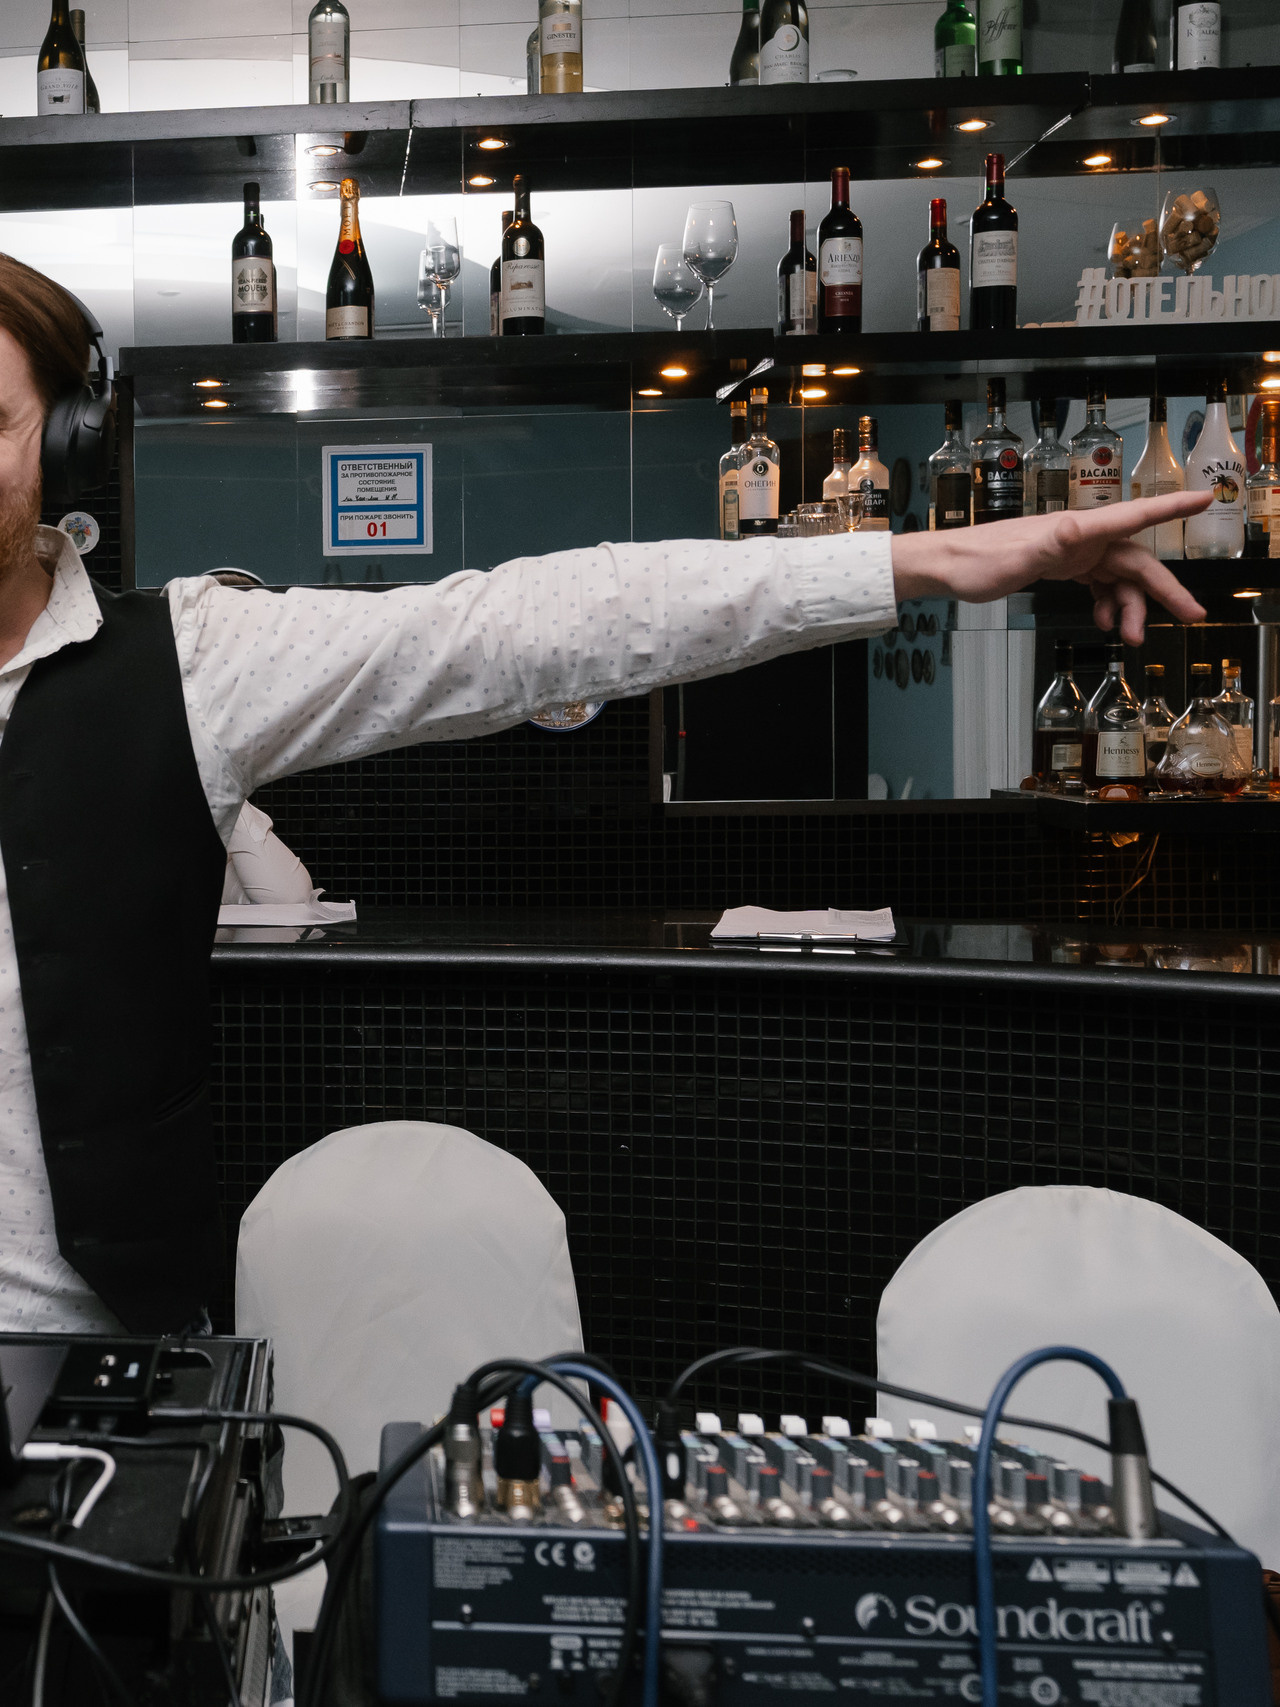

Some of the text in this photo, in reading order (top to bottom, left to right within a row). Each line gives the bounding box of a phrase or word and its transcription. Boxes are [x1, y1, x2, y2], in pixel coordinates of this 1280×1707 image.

[828, 253, 861, 264] ARIENZO
[341, 461, 413, 471] ОТВЕТСТВЕННЫЙ
[744, 480, 776, 488] ОНЕГИН
[367, 521, 387, 537] 01
[1104, 746, 1140, 756] Hennessy
[904, 1594, 1154, 1644] Soundcraft
